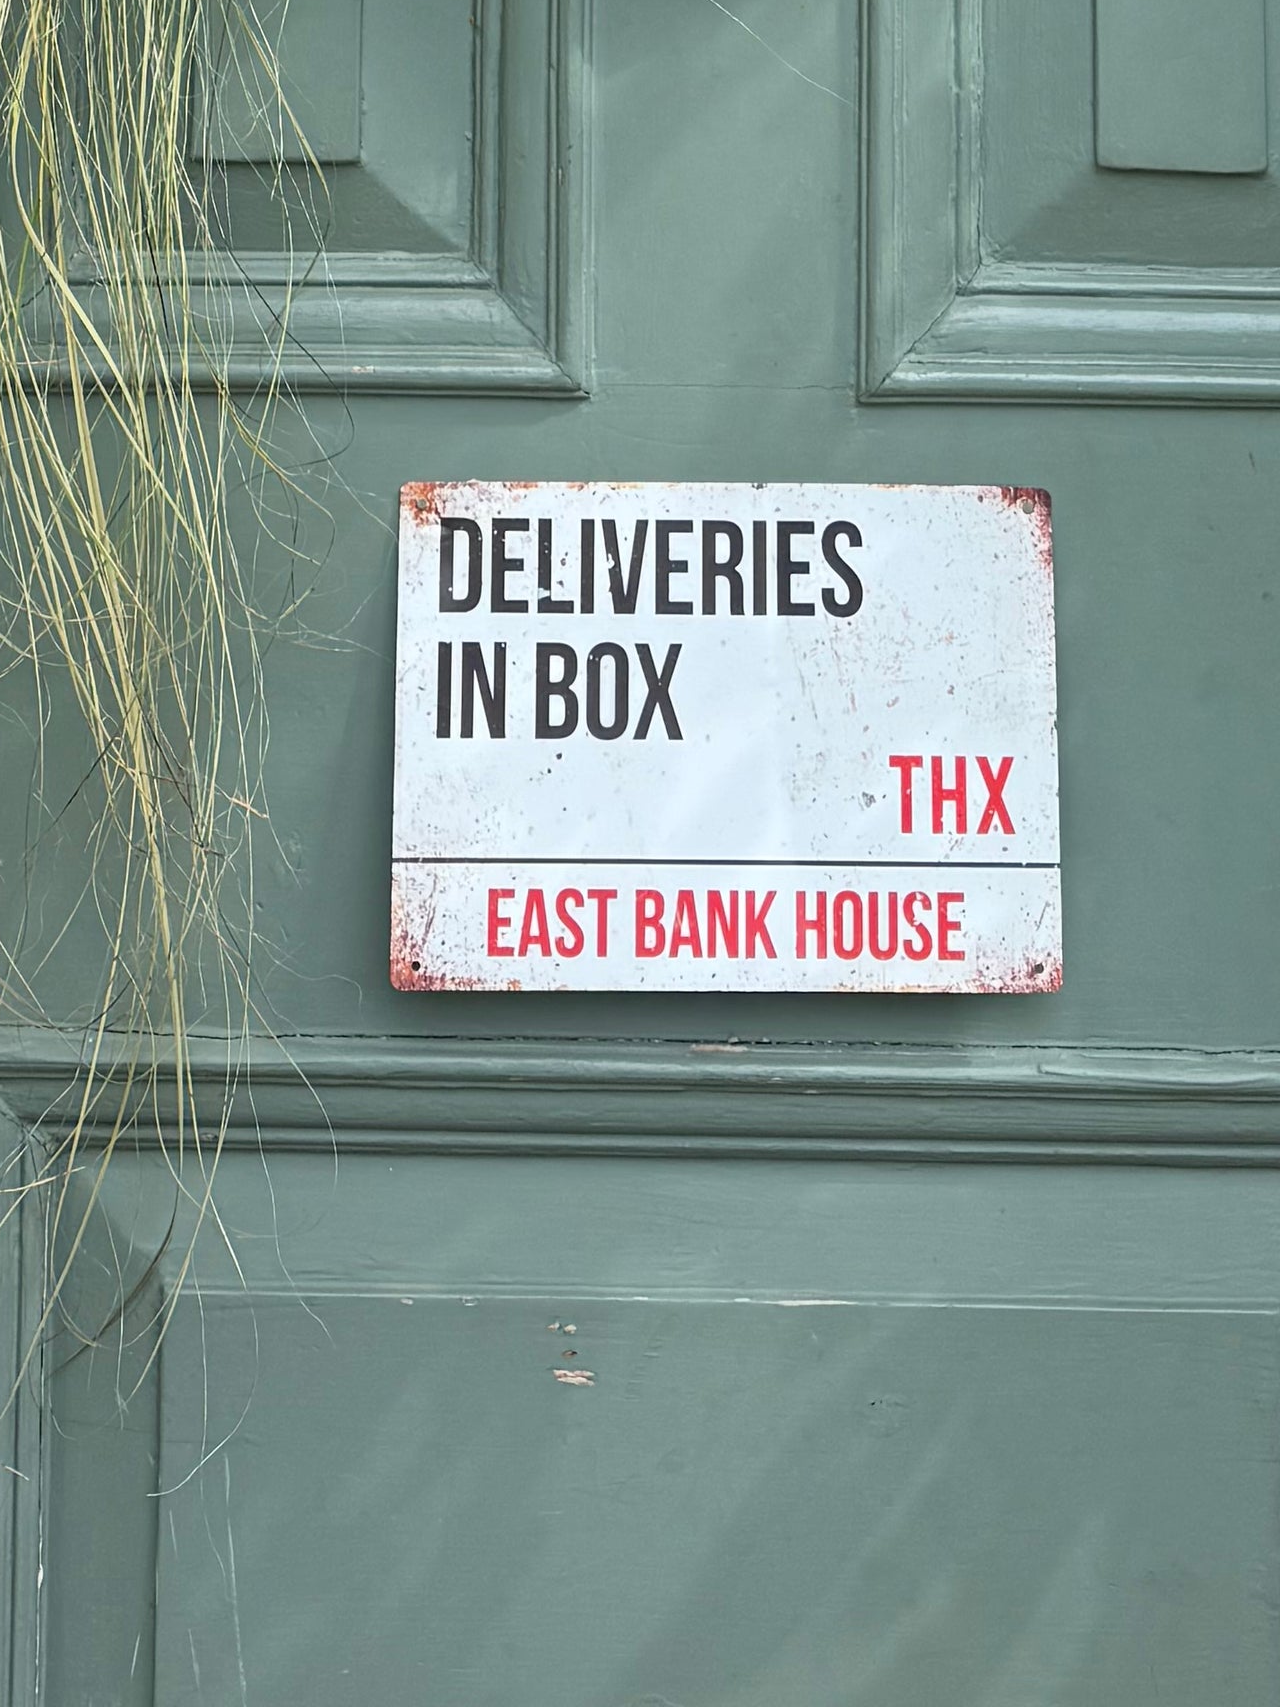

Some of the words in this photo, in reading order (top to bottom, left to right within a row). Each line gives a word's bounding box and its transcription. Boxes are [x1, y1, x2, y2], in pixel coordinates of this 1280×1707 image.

[436, 517, 864, 618] DELIVERIES
[435, 641, 507, 740] IN
[534, 641, 684, 740] BOX
[889, 755, 1016, 835] THX
[486, 888, 618, 958] EAST
[634, 890, 777, 959] BANK
[794, 891, 966, 961] HOUSE
